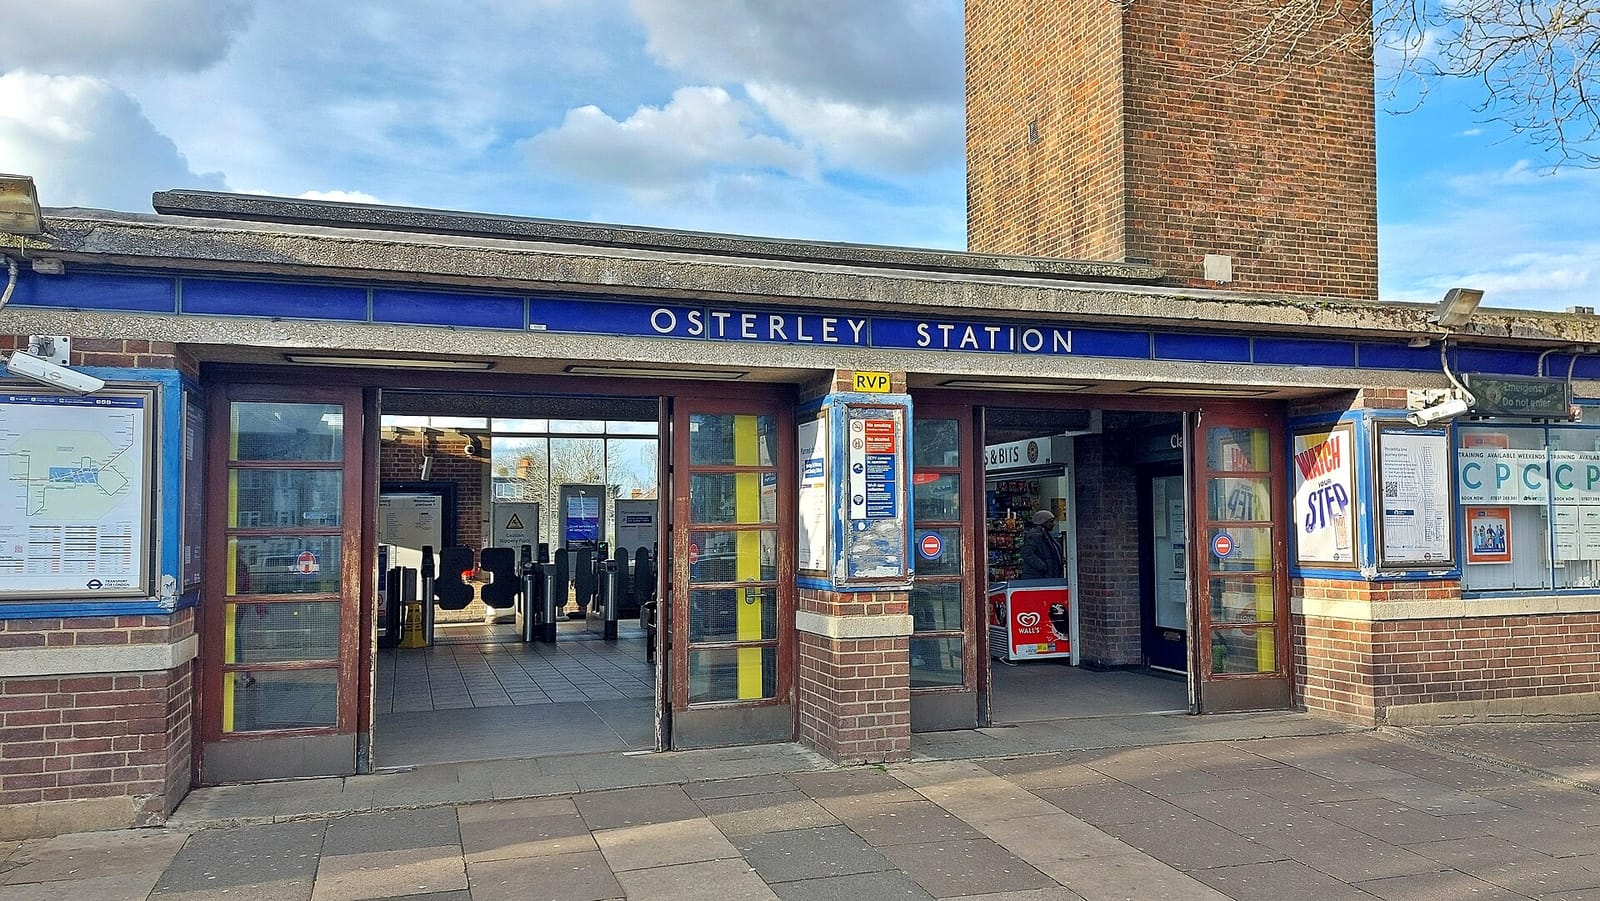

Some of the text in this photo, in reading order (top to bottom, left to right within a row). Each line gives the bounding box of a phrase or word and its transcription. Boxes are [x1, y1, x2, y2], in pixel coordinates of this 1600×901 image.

[650, 308, 1072, 352] OSTERLEY STATION
[857, 375, 887, 389] RVP
[1504, 383, 1548, 395] Emergency
[1503, 397, 1551, 408] Do not enter
[990, 449, 997, 465] &
[998, 446, 1019, 464] BITS
[1295, 436, 1340, 480] WATCH
[1318, 479, 1332, 488] YOUR
[1305, 482, 1349, 533] STEP
